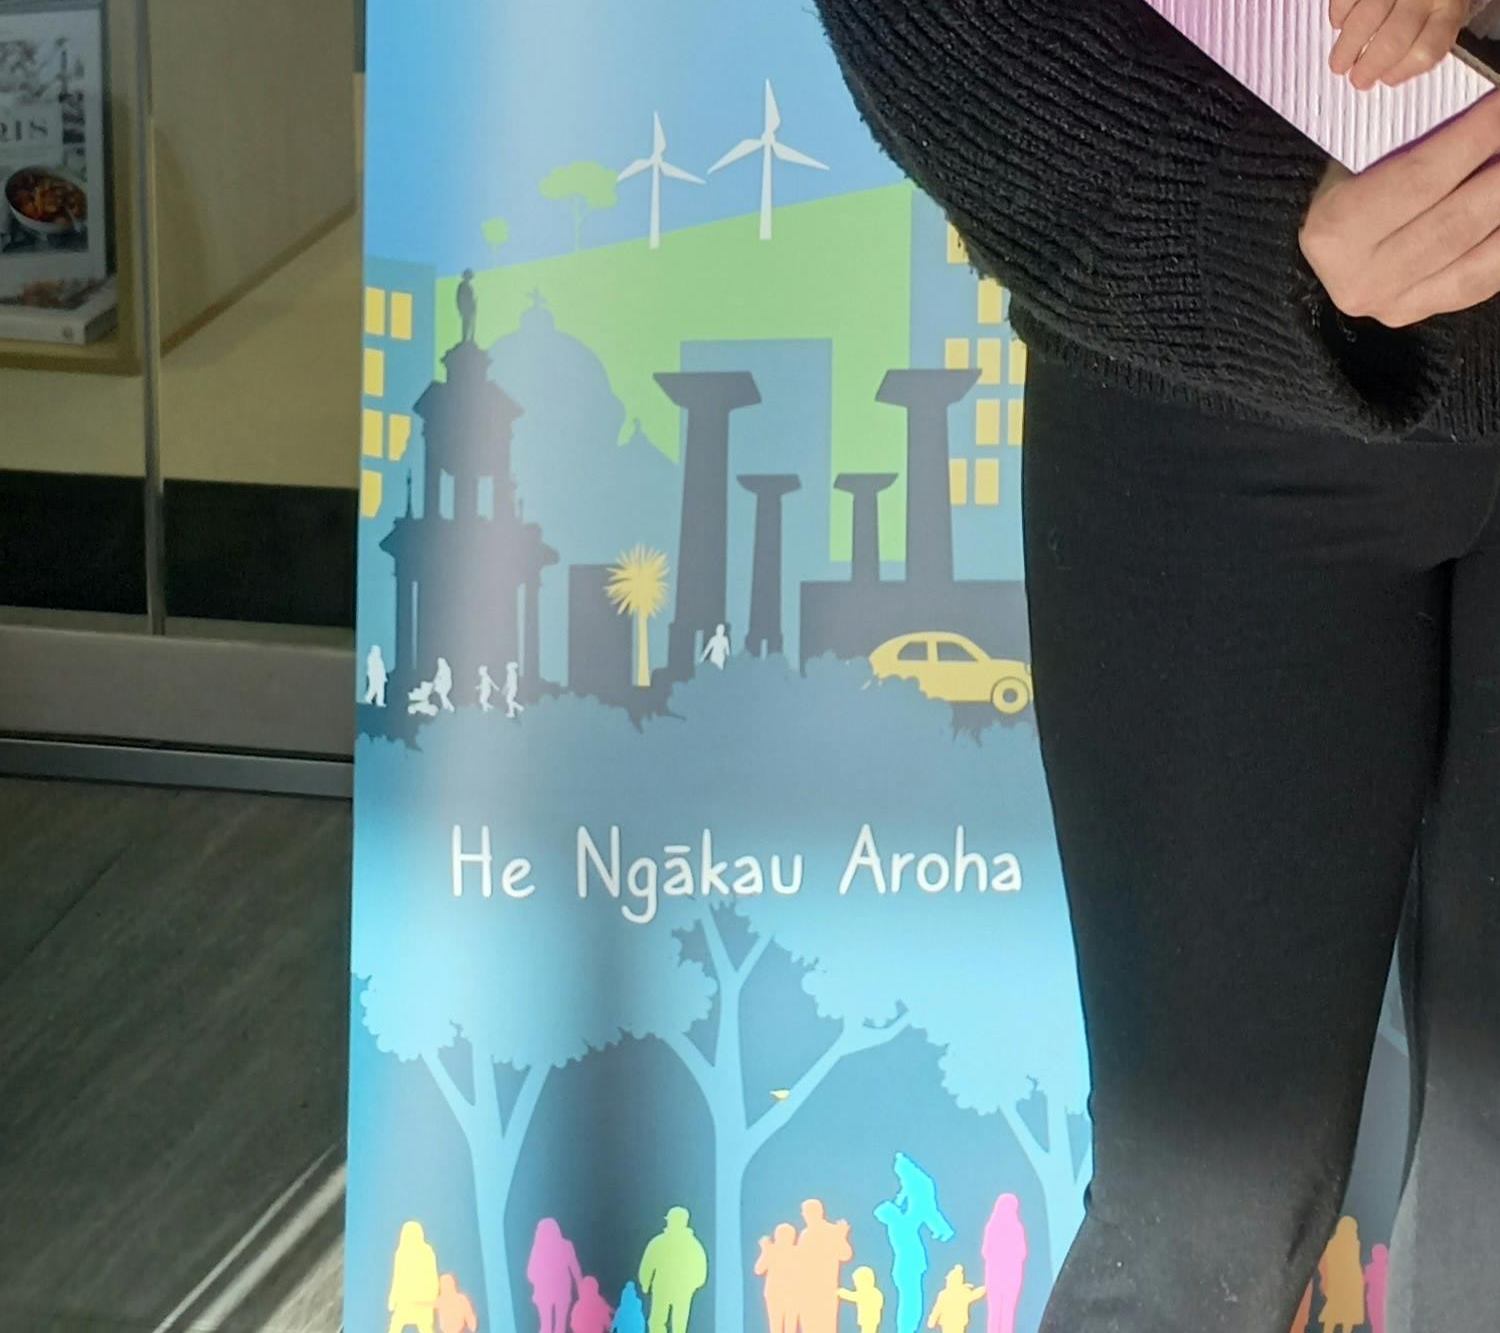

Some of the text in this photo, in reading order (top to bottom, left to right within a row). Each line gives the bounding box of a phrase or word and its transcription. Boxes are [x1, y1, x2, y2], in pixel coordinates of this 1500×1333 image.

[450, 824, 536, 899] He
[575, 824, 804, 925] Ngākau
[837, 822, 1023, 896] Aroha
